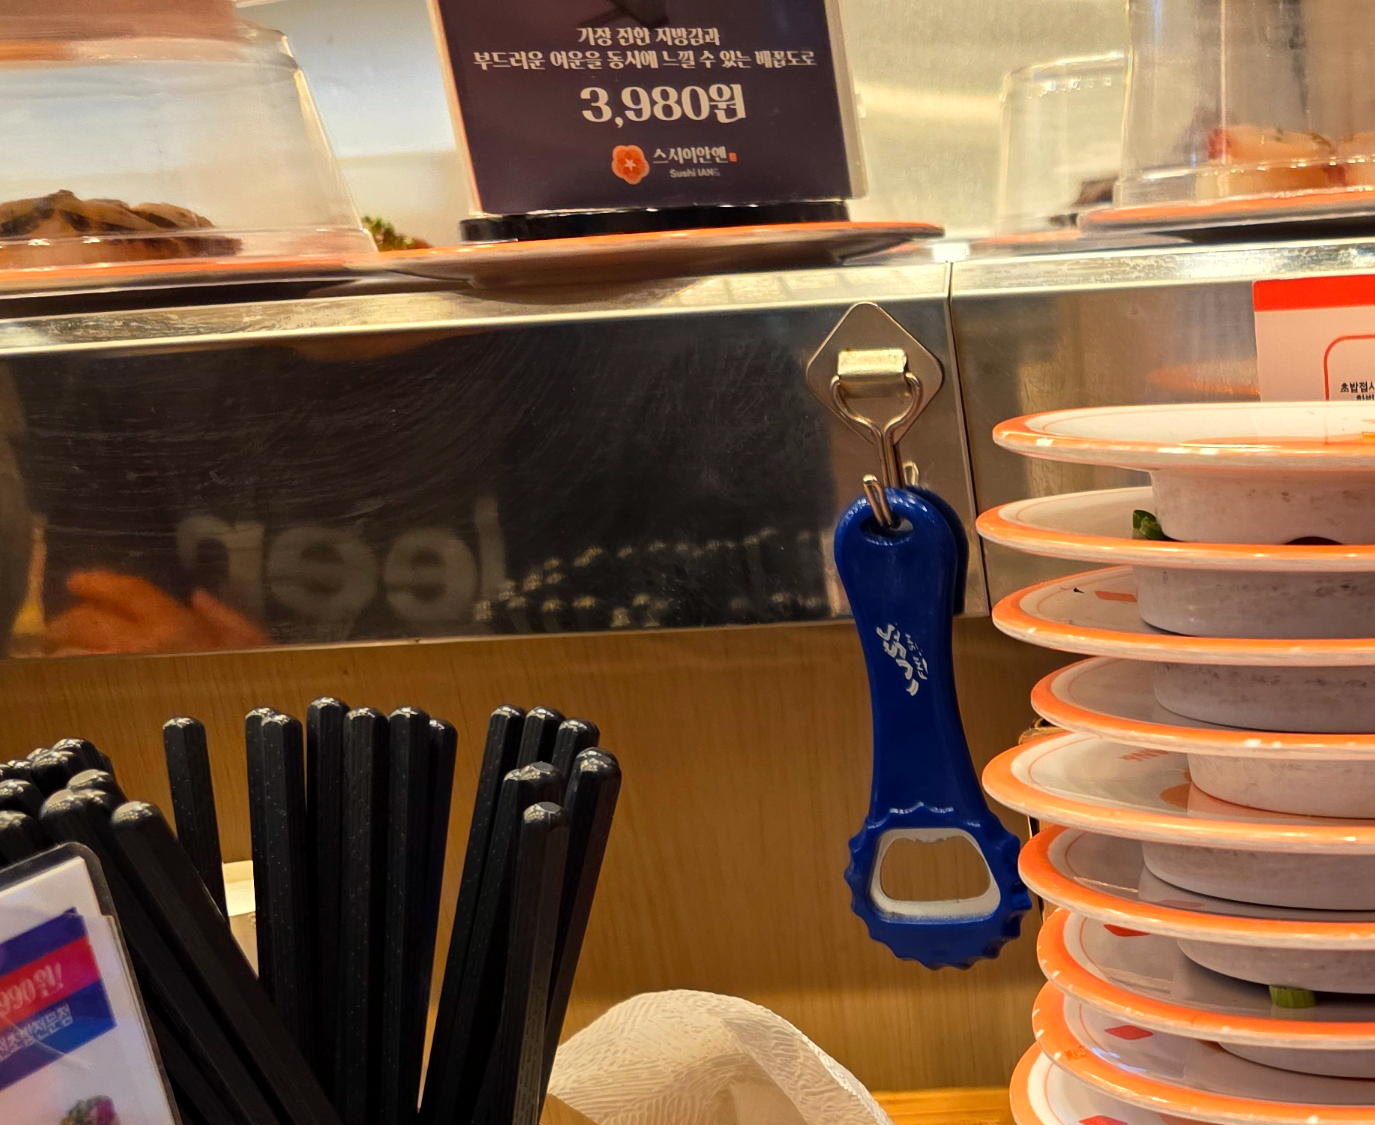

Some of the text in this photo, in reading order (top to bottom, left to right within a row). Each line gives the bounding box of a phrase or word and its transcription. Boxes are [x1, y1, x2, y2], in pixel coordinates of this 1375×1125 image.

[576, 27, 721, 46] 가장 진한 지방감과
[473, 50, 818, 70] 부드러운 여운을 동시에 느낄 수 있는 배꼽도로
[579, 83, 747, 128] 3,980원
[652, 146, 729, 164] 스시이안앤
[669, 168, 697, 178] Sushi
